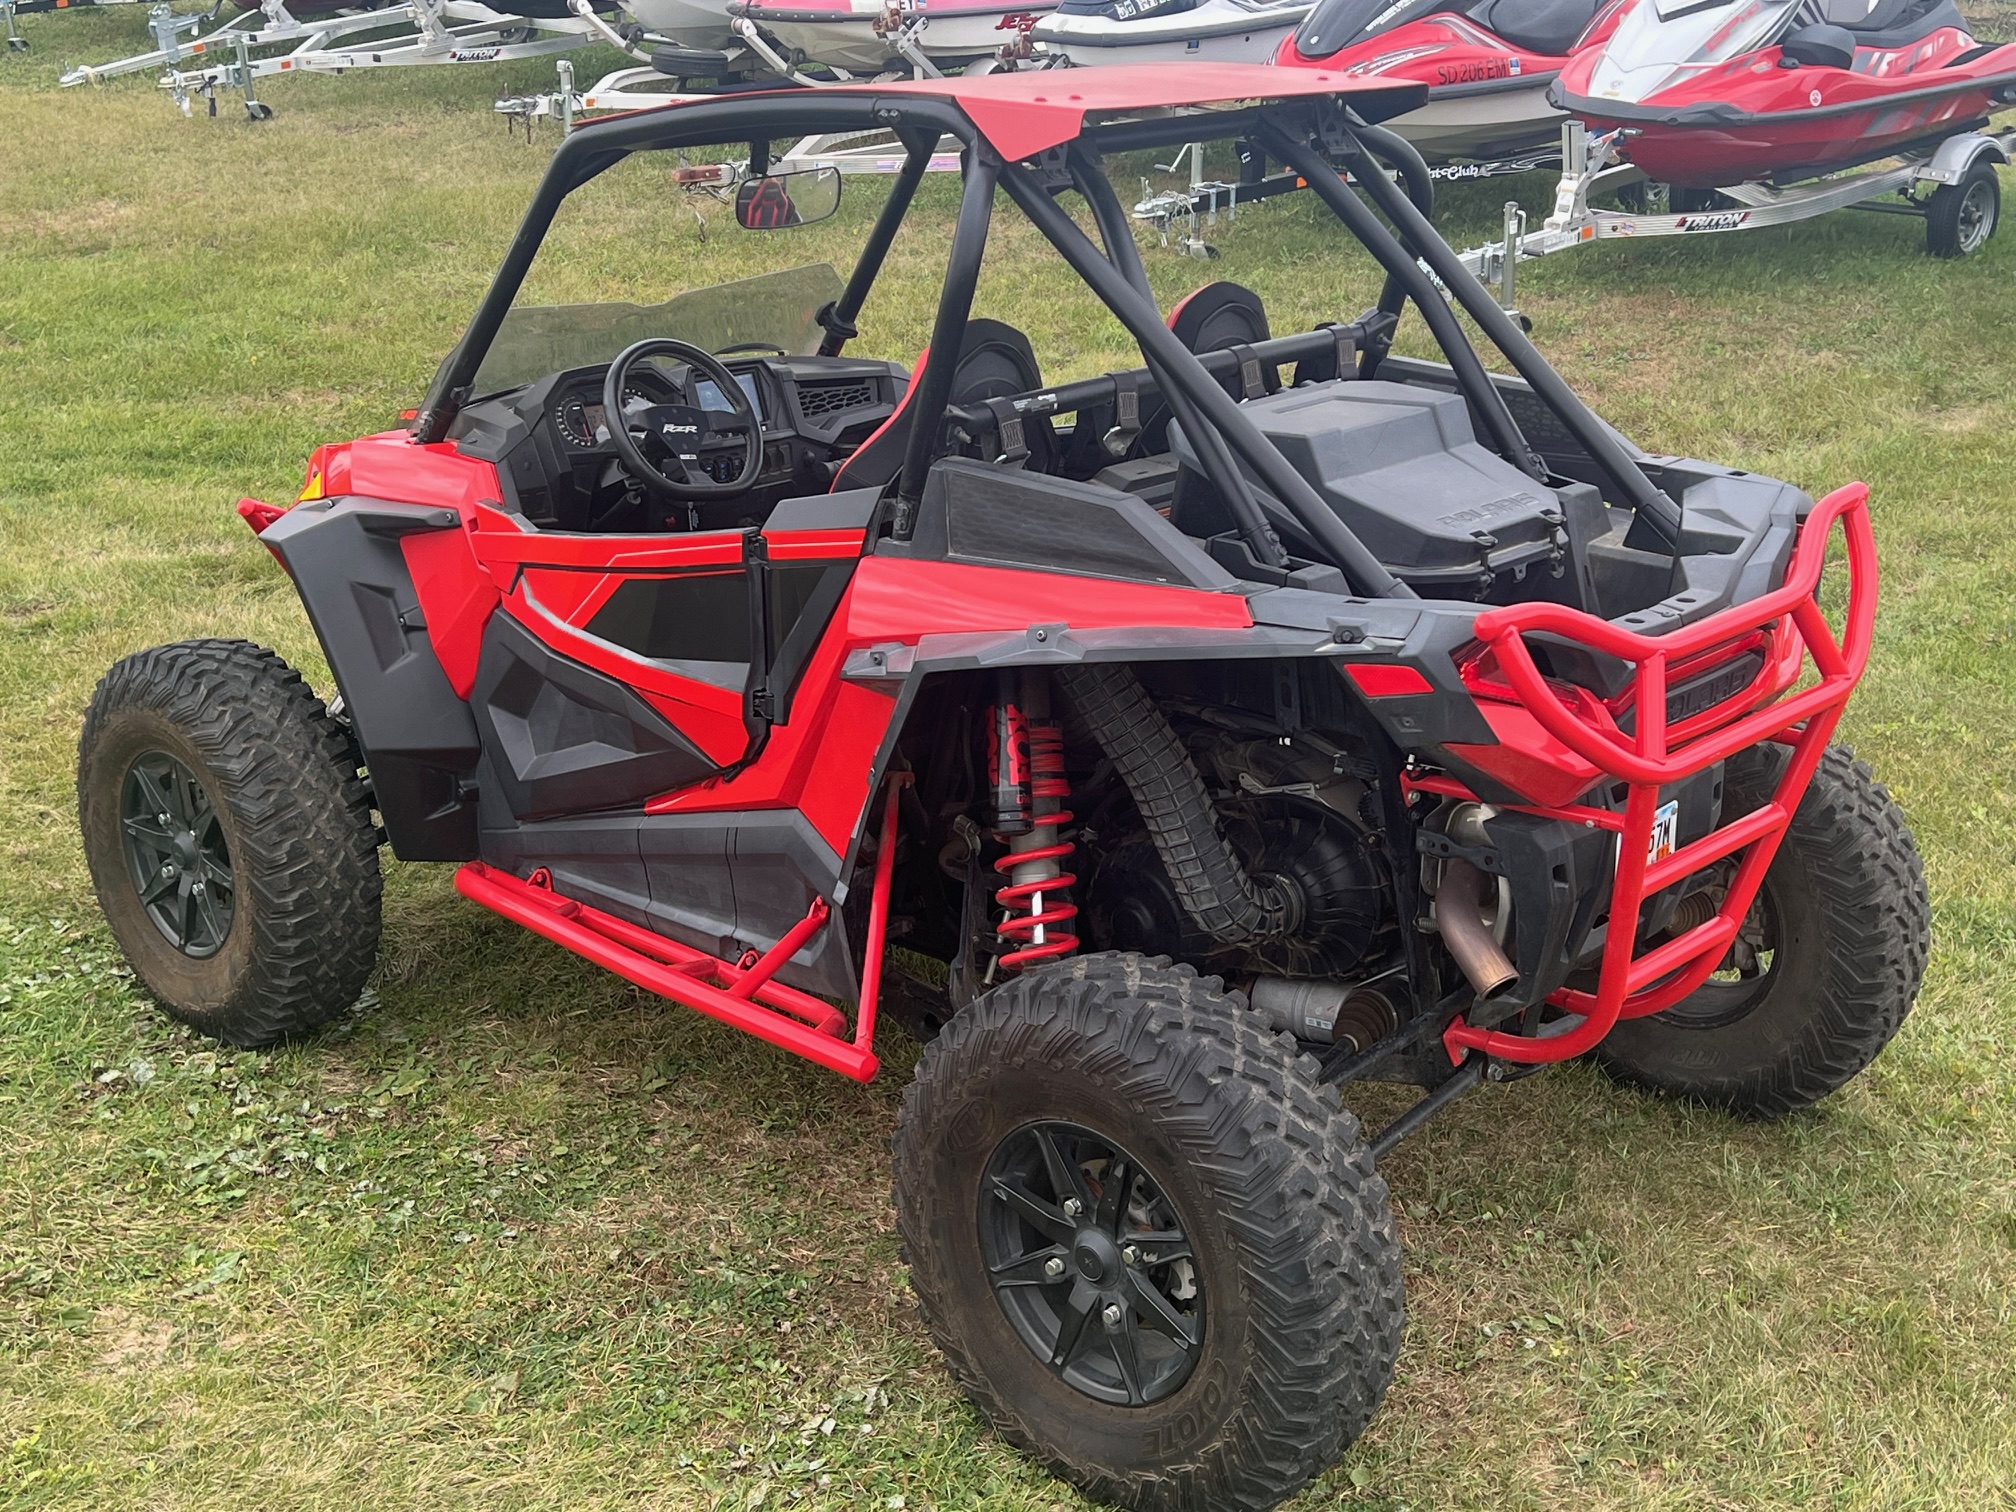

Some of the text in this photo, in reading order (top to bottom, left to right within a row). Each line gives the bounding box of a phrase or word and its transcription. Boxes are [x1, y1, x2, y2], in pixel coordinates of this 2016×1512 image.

[457, 49, 498, 58] TRITON
[1437, 58, 1507, 85] SD 206 EM
[1684, 212, 1746, 229] TRITON
[662, 423, 698, 434] RZR
[1435, 492, 1540, 529] POLARIS
[1667, 664, 1747, 724] OLARIS
[1141, 1357, 1230, 1459] COYOTE
